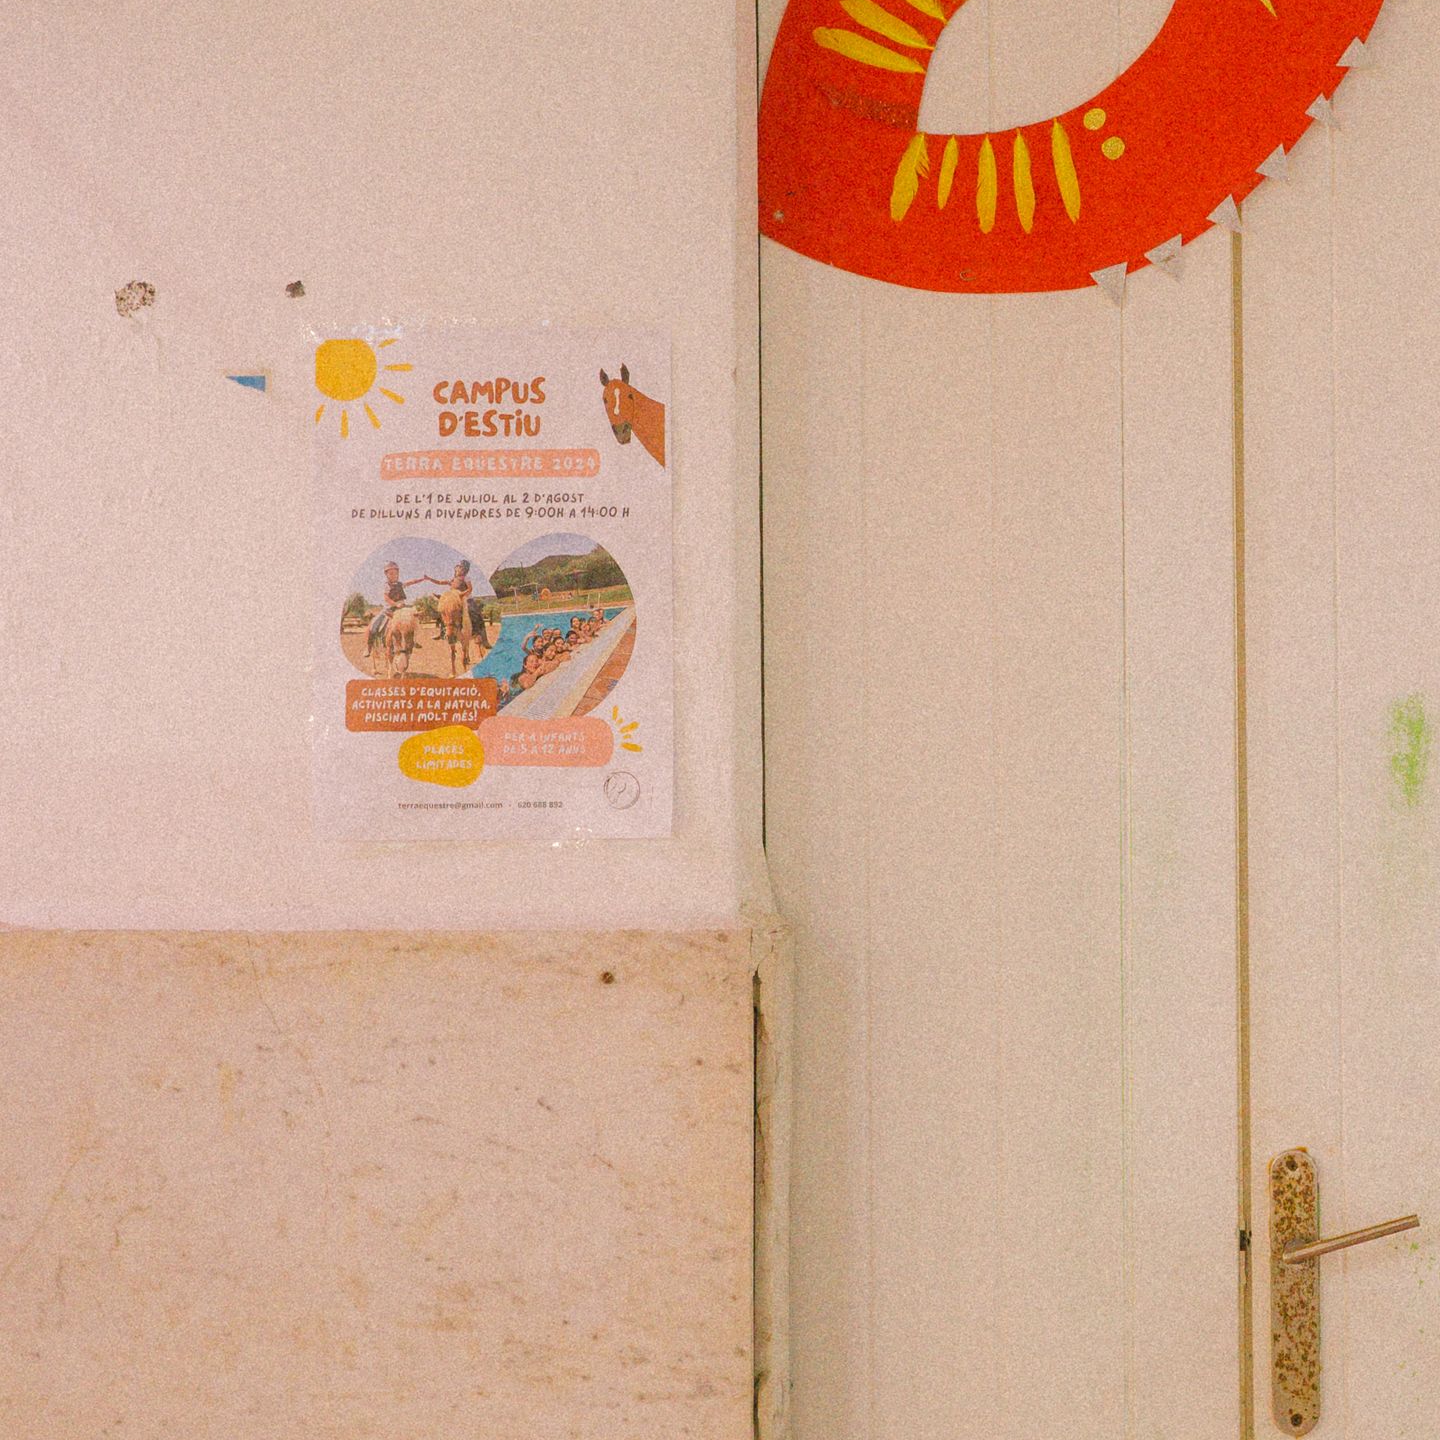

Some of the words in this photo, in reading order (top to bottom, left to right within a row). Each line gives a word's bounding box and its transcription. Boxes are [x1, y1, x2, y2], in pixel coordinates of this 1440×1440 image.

[432, 376, 546, 405] CAMPUS
[384, 457, 443, 471] TERRA
[451, 456, 543, 471] EQUESTRE
[396, 494, 410, 504] DE
[437, 494, 451, 504] DE
[456, 493, 498, 504] JULIOL
[503, 494, 517, 504] AL
[522, 492, 529, 504] 2
[534, 493, 584, 504] D'AGOST
[351, 509, 366, 519] DE
[370, 508, 420, 520] DILLUNS
[425, 509, 432, 519] A
[436, 508, 502, 520] DIVENDRES
[506, 508, 521, 518] DE
[525, 506, 564, 519] 9:00H
[569, 508, 576, 518] A
[581, 505, 618, 518] 14:00
[622, 507, 630, 518] H
[361, 687, 407, 697] CLASSES
[352, 699, 414, 711] ACTIVITATS
[416, 699, 424, 710] A
[427, 700, 441, 710] LA
[364, 712, 407, 723] PISCINA
[417, 712, 449, 723] MOLT
[423, 745, 465, 755] PLACES
[416, 759, 473, 770] LIMITADES
